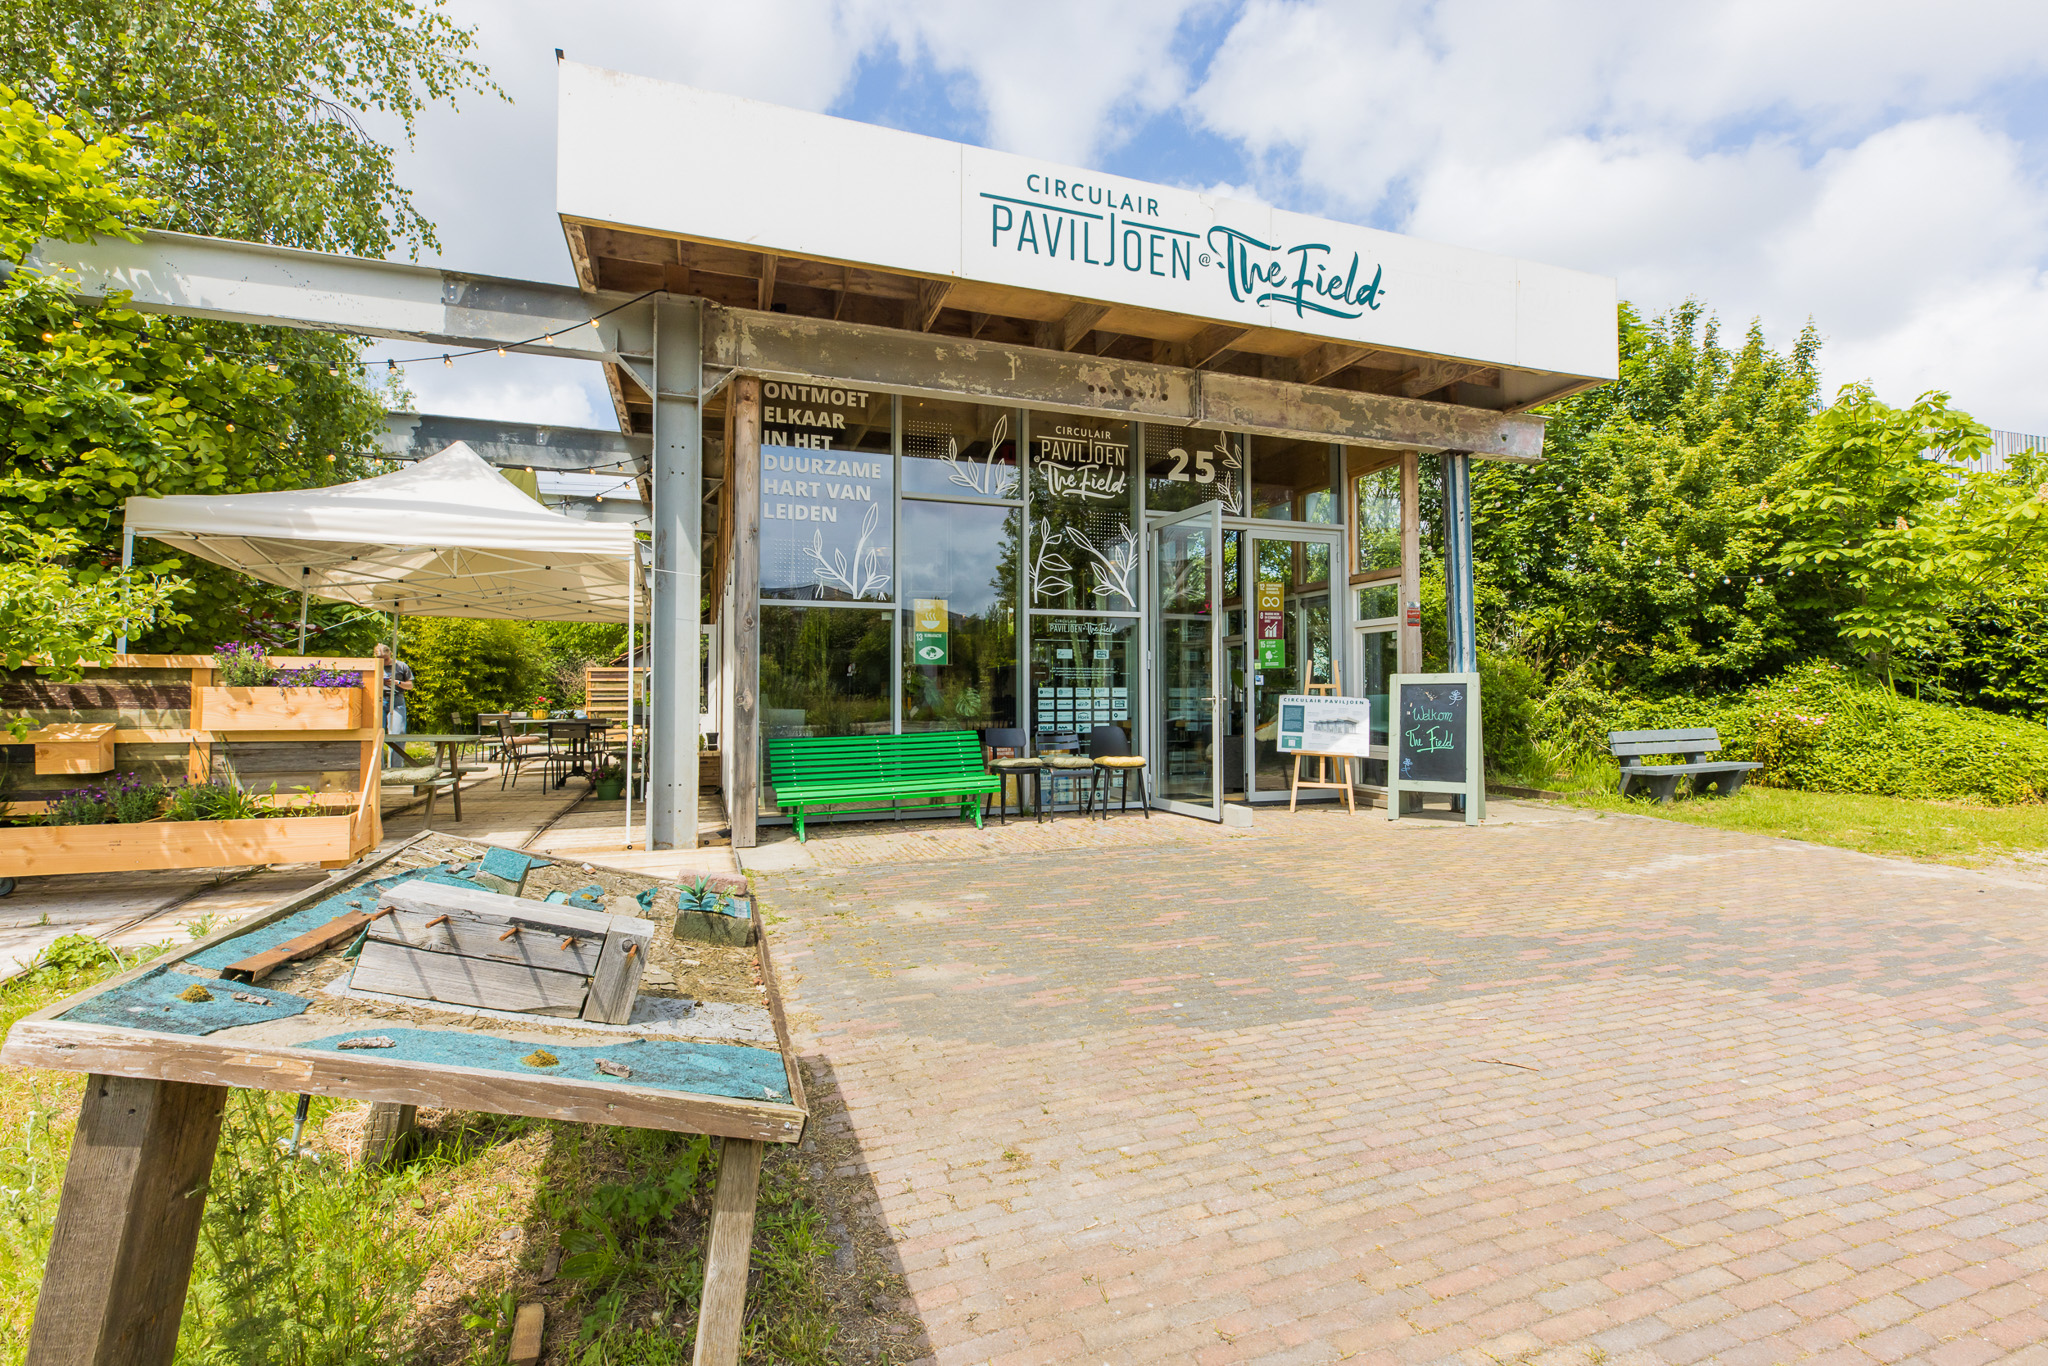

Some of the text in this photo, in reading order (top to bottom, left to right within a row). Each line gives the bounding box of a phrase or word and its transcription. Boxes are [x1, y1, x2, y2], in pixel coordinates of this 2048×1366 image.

[1026, 174, 1160, 217] CIRCULAIR
[993, 204, 1191, 281] PAVILJOEN
[1207, 225, 1288, 302] The
[1277, 243, 1386, 319] Field
[763, 382, 869, 408] ONTMOET
[763, 406, 846, 429] ELKAAR
[763, 430, 833, 451] IN HET
[1055, 425, 1111, 440] CIRCULAIR
[1041, 439, 1125, 466] PAVILJOEN
[763, 454, 882, 479] DUURZAME
[1168, 448, 1215, 484] 25
[763, 478, 871, 501] HART VAN
[1038, 460, 1077, 496] The
[1070, 464, 1127, 500] Field
[763, 502, 837, 523] LEIDEN
[1412, 705, 1453, 722] Welkom
[1405, 724, 1455, 753] The Field
